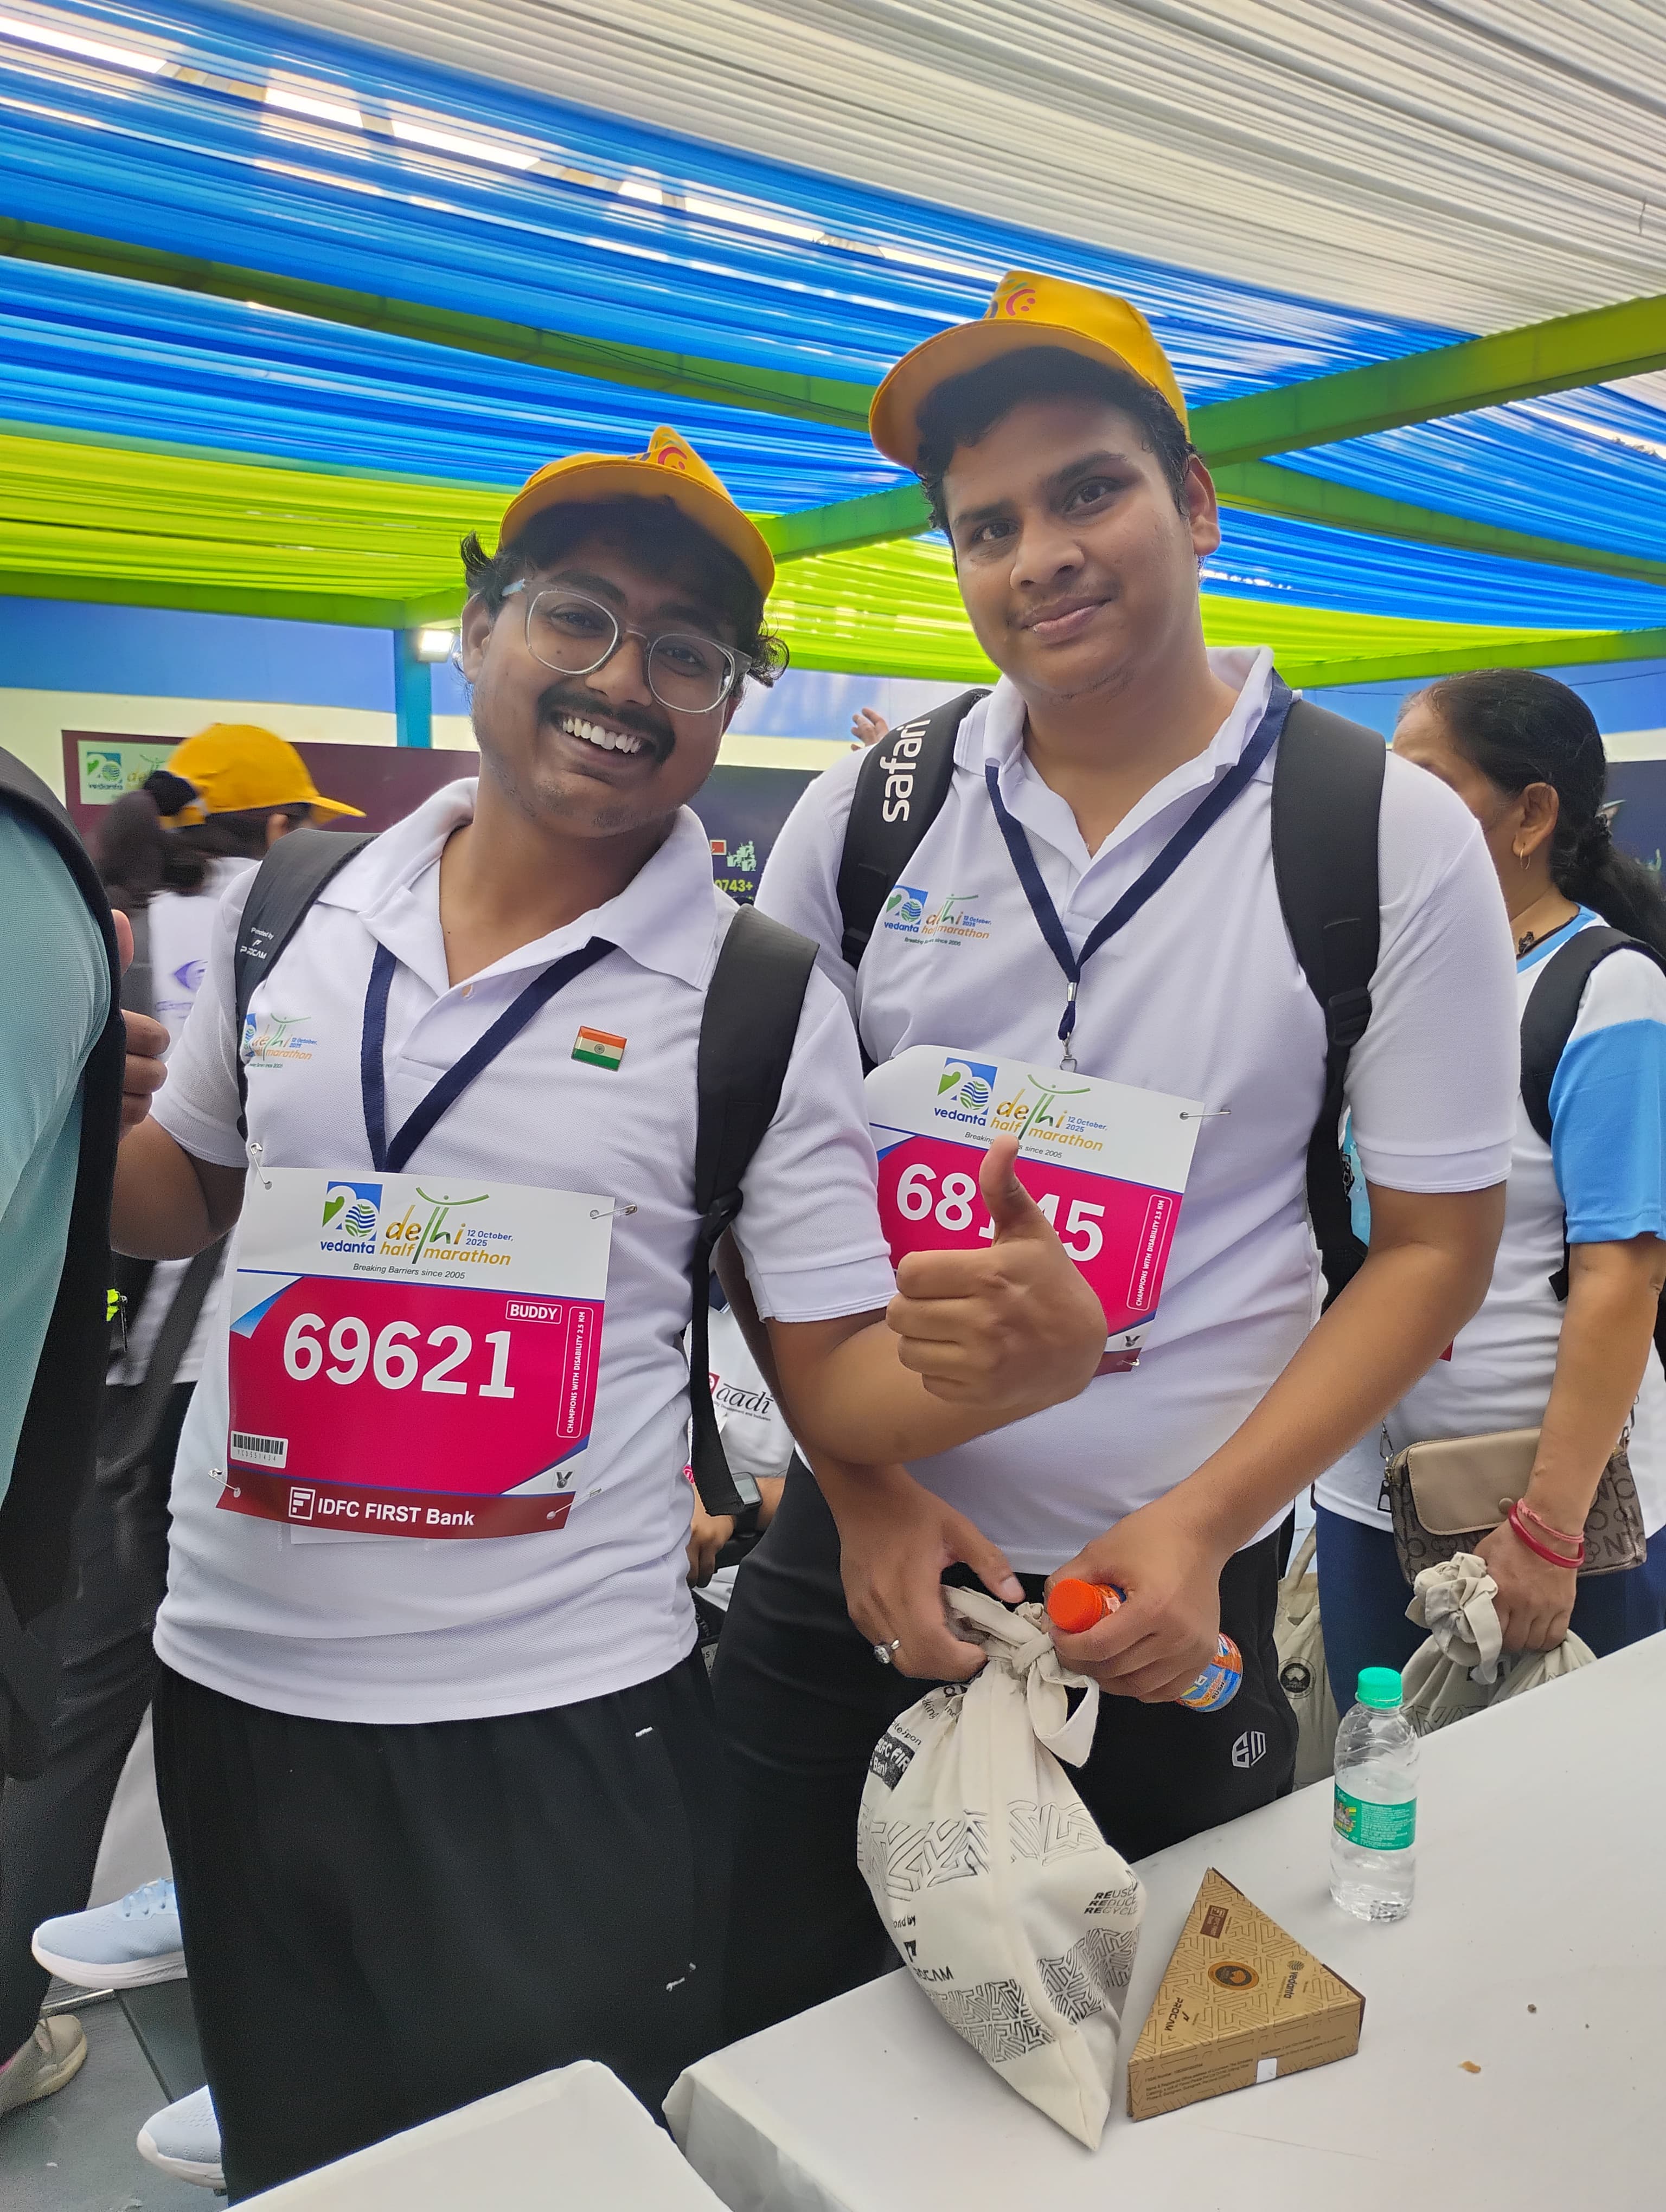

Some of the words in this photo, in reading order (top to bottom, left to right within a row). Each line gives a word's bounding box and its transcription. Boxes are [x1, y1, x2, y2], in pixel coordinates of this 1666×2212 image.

[879, 719, 931, 822] safari
[883, 921, 919, 933] vedanta
[937, 925, 990, 939] marathon
[266, 1049, 312, 1060] marathon
[934, 1107, 986, 1127] vedanta
[996, 1088, 1068, 1140] delhi
[990, 1116, 1023, 1133] half
[1028, 1127, 1104, 1152] marathon
[1065, 1123, 1085, 1133] 2025
[964, 1131, 995, 1145] Breaking
[1024, 1144, 1043, 1155] since
[1045, 1149, 1063, 1159] 2005
[1156, 1199, 1165, 1210] KM
[386, 1205, 466, 1264] delhi
[467, 1229, 476, 1238] 12
[1146, 1220, 1160, 1252] DISABILITY
[320, 1239, 376, 1254] vedanta
[465, 1238, 488, 1247] 2025
[379, 1240, 416, 1257] half
[423, 1247, 511, 1265] marathon
[1143, 1253, 1152, 1270] WITH
[353, 1263, 387, 1274] Breaking
[388, 1266, 419, 1276] Barriers
[421, 1269, 443, 1277] since
[444, 1270, 465, 1279] 2005
[1135, 1270, 1148, 1307] CHAMPIONS
[510, 1303, 558, 1320] BUDDY
[578, 1311, 586, 1322] KM
[284, 1313, 515, 1399] 69621
[573, 1335, 584, 1371] DISABILITY
[571, 1372, 580, 1391] WITH
[566, 1392, 578, 1433] CHAMPIONS
[317, 1497, 360, 1518] IDFC
[364, 1502, 421, 1523] FIRST
[426, 1508, 476, 1526] Bank
[1088, 1894, 1136, 1907] REDUCE
[1094, 1885, 1134, 1900] REUSE
[1284, 1971, 1299, 1999] vedanta
[1164, 1997, 1184, 2031] PROCAM
